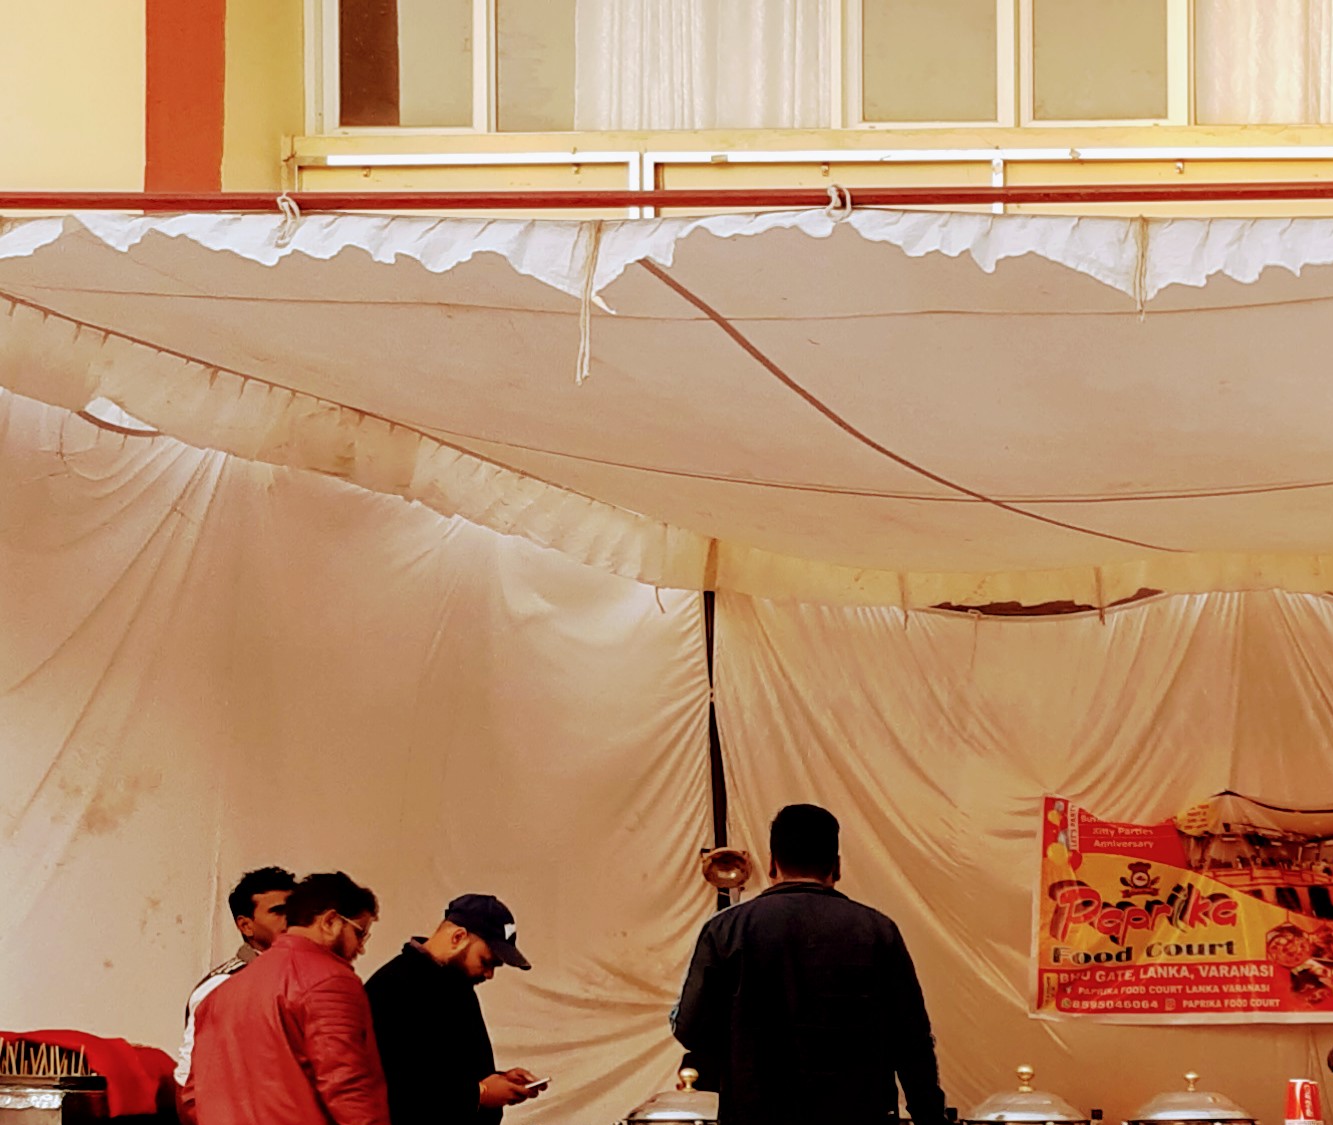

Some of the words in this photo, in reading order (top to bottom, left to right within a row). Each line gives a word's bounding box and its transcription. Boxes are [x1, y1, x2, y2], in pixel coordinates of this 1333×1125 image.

[1048, 880, 1239, 947] Paprika
[1053, 946, 1133, 965] Food
[1146, 940, 1236, 958] Court
[1199, 965, 1274, 978] VARANASI
